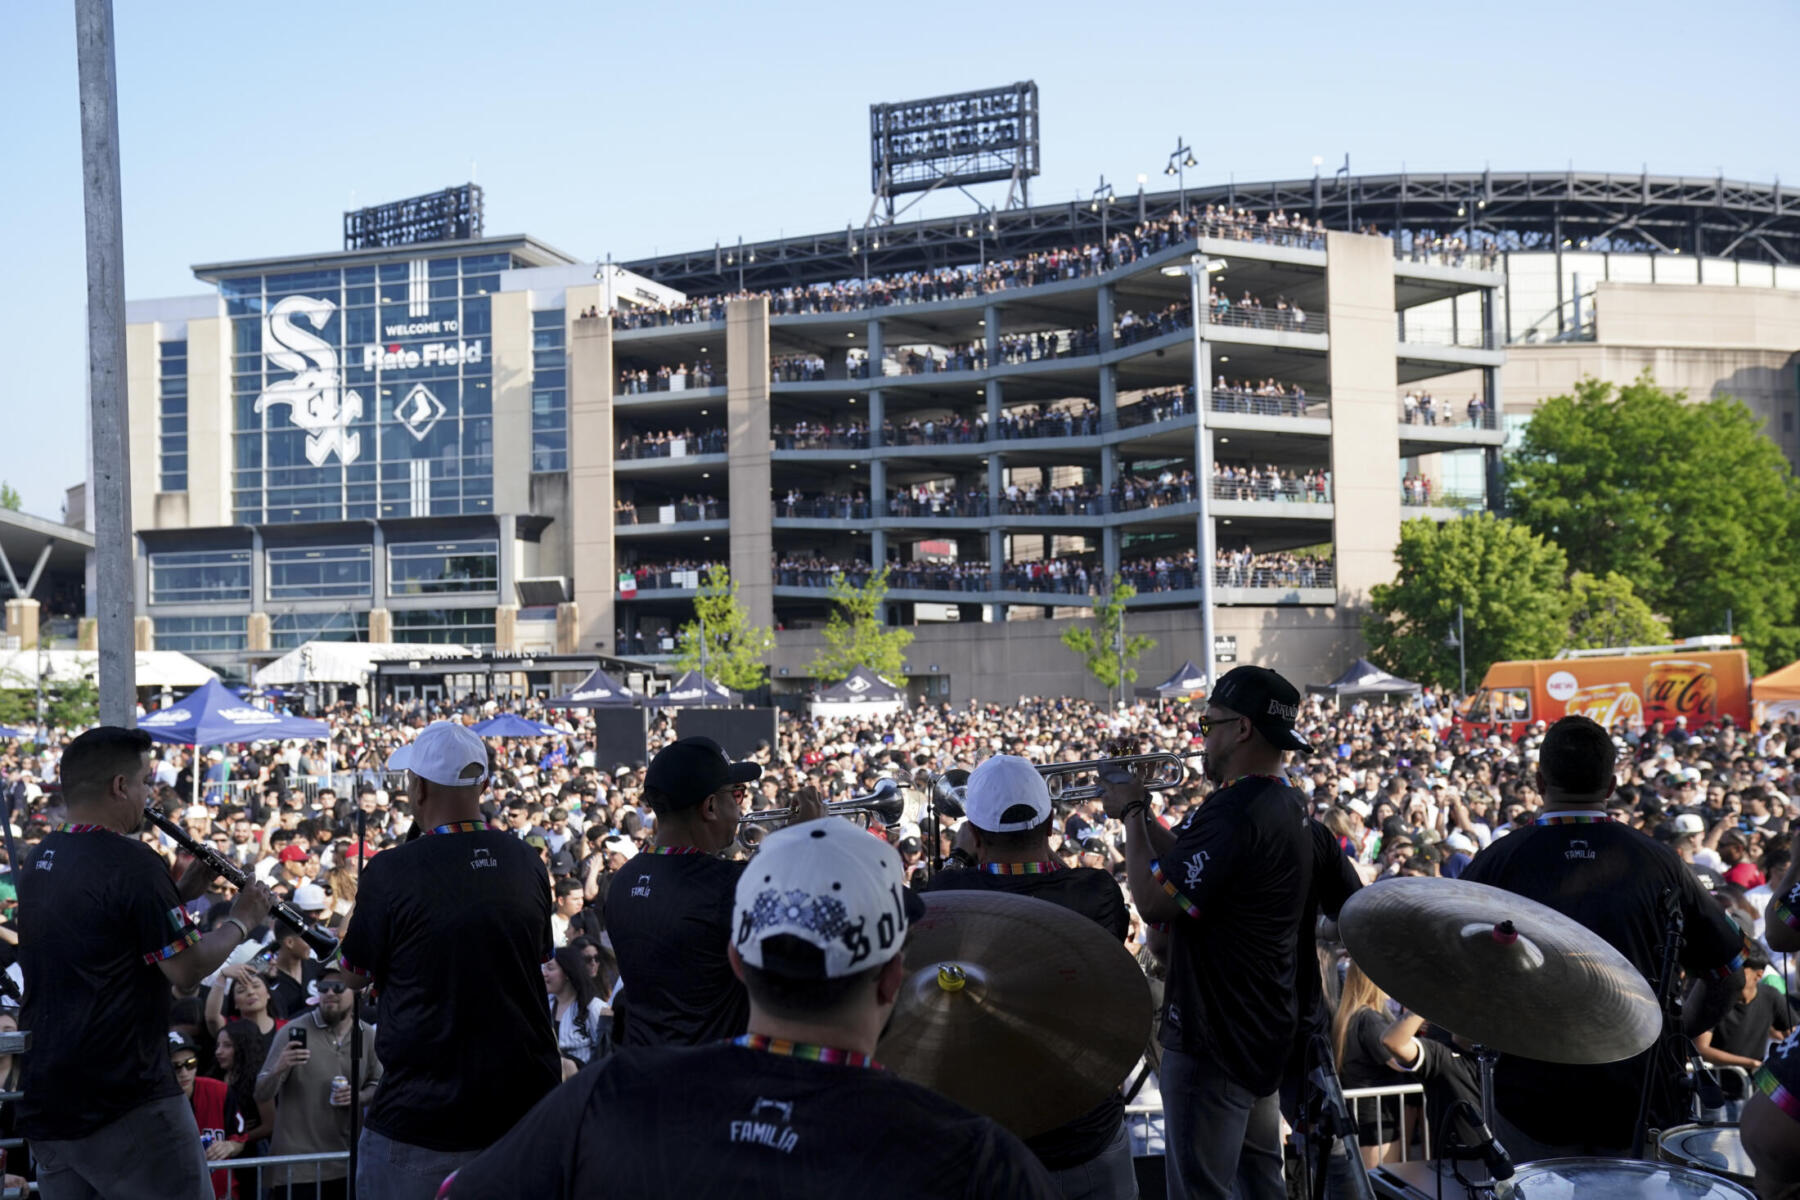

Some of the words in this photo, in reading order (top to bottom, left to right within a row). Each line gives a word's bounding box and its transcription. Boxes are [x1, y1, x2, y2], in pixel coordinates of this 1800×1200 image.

[385, 321, 440, 336] WELCOME
[442, 320, 458, 332] TO
[363, 343, 420, 371] Rate
[422, 340, 481, 367] Field
[471, 643, 483, 659] 5
[1549, 682, 1575, 690] NEW
